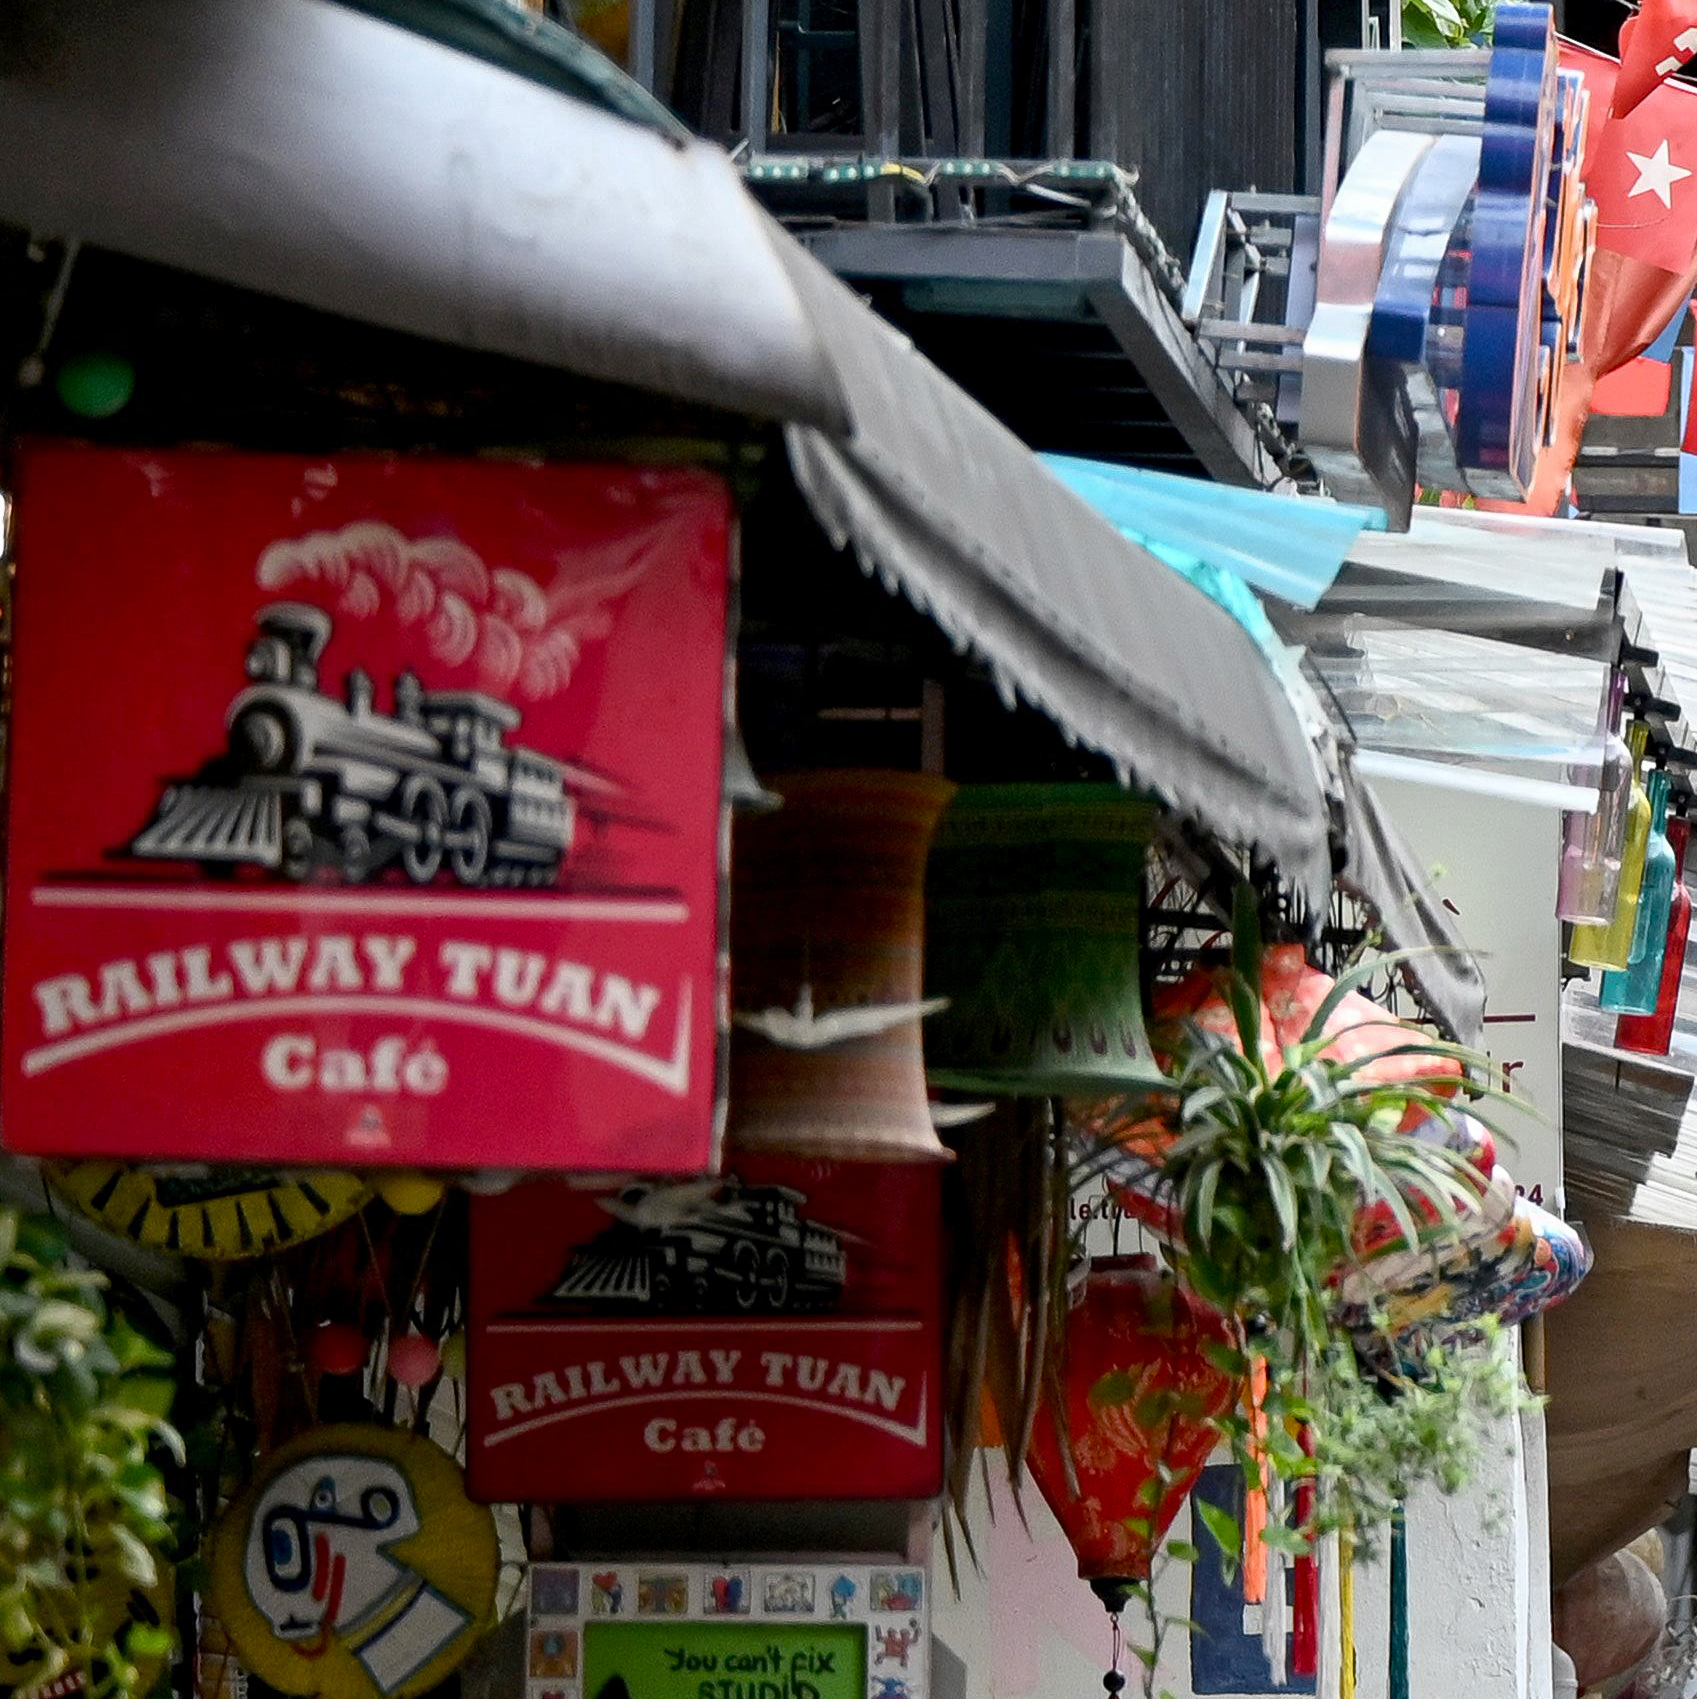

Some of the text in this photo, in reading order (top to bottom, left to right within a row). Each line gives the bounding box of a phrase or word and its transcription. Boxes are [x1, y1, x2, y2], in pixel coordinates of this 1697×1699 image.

[32, 934, 662, 1037] RAILWAY TUAN
[261, 1034, 449, 1095] Café
[489, 1349, 906, 1421] RAILWAY TUAN
[643, 1416, 767, 1454] Café
[664, 1646, 718, 1673] You
[724, 1644, 783, 1673] can't
